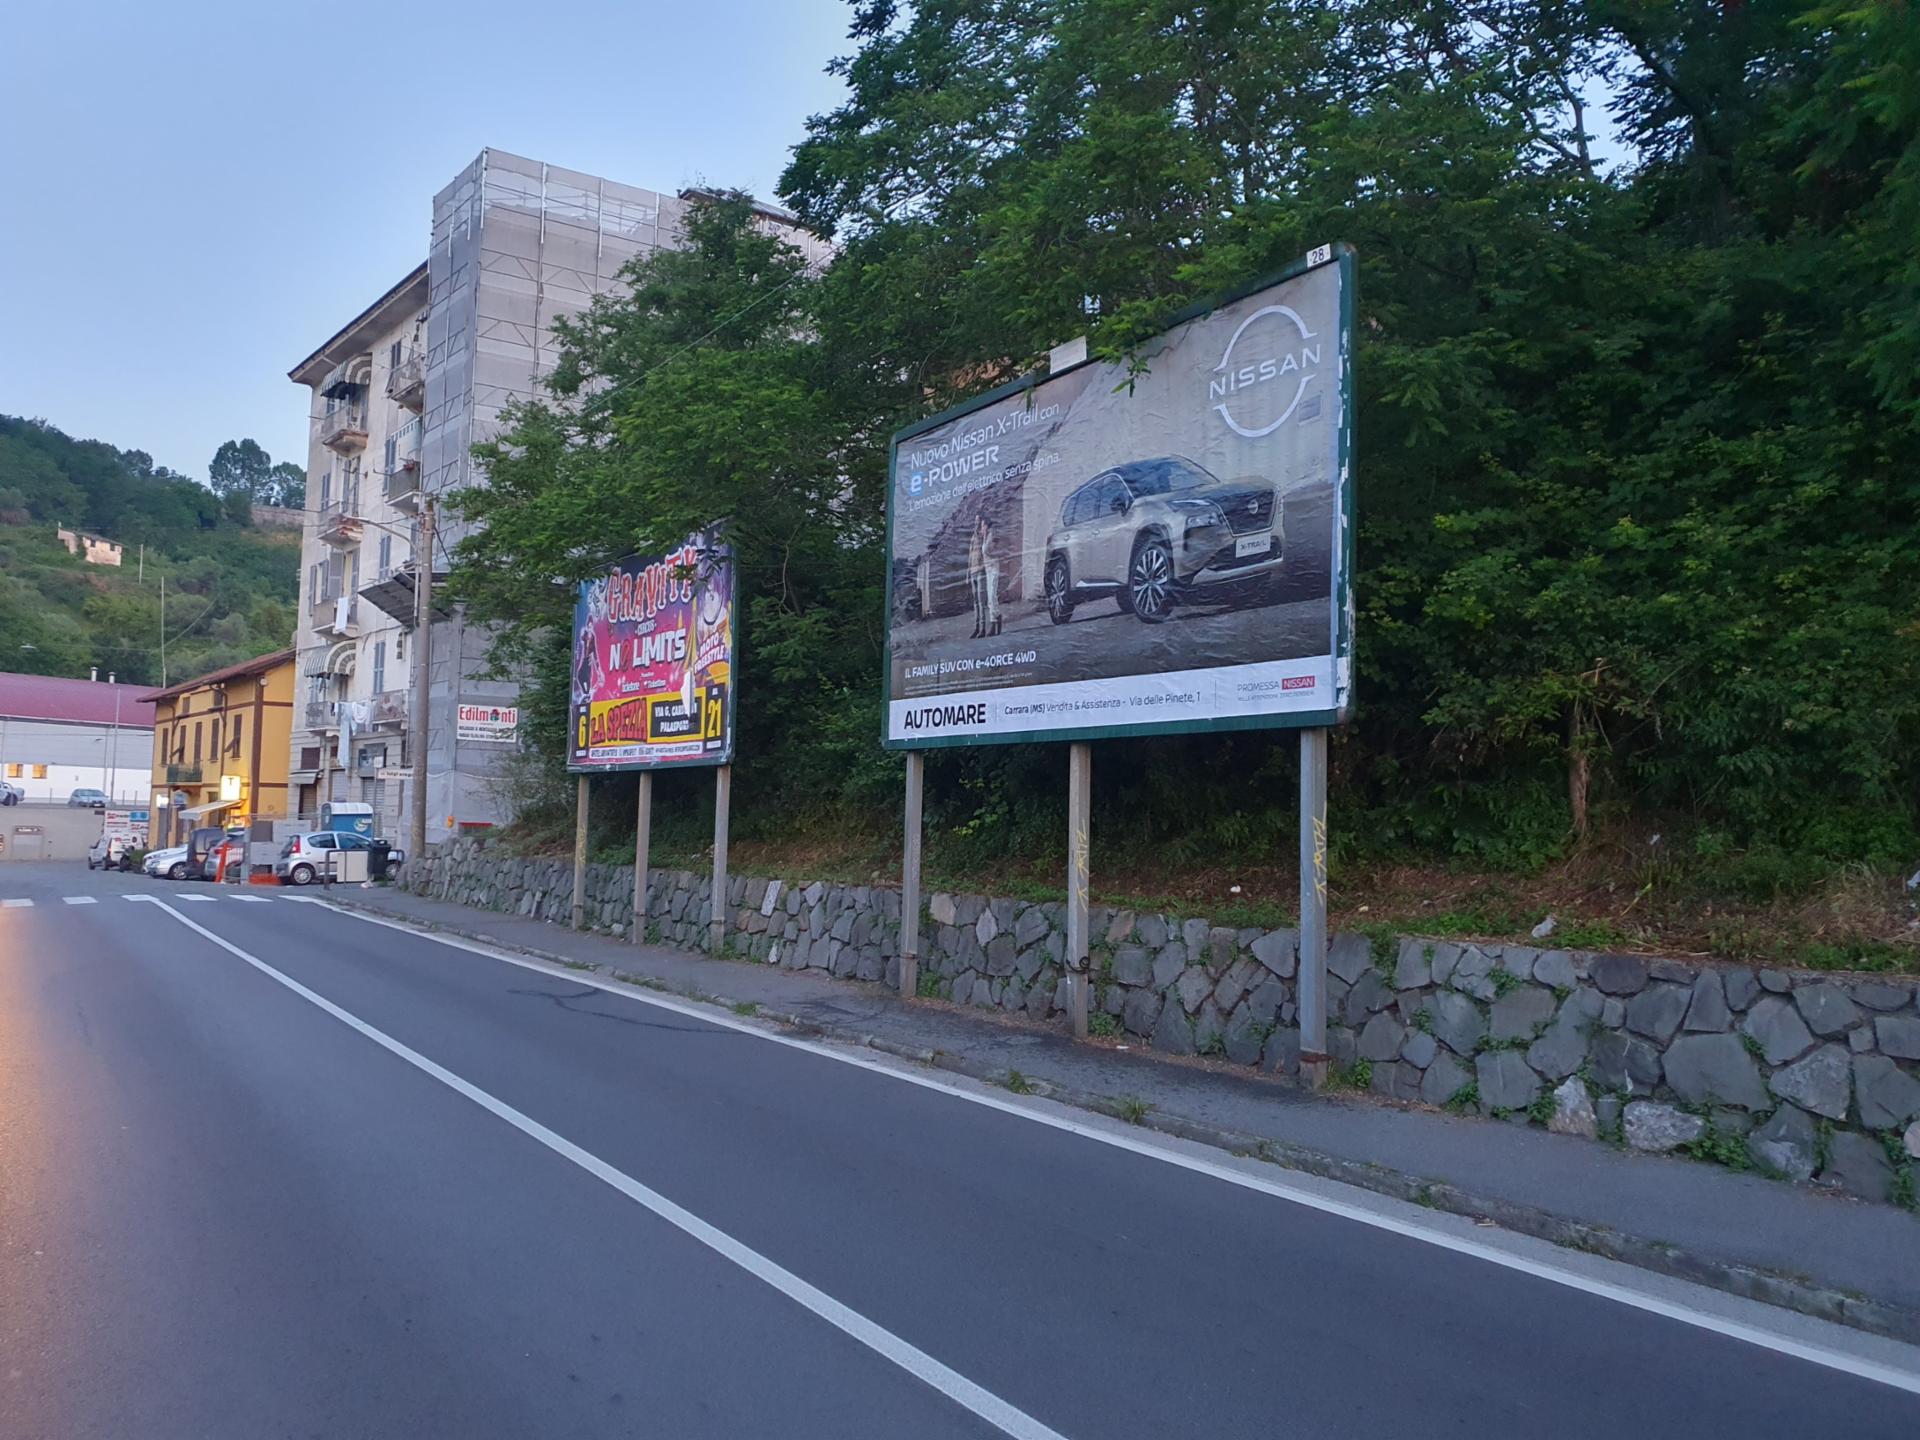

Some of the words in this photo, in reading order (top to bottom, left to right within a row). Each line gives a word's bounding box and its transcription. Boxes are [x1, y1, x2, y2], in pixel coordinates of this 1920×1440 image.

[1312, 248, 1325, 264] 28
[1209, 343, 1321, 400] NISSAN
[911, 443, 948, 469] Nuovo
[951, 424, 994, 450] Nissan
[996, 402, 1039, 437] X-Trail
[1040, 402, 1060, 420] con
[1004, 461, 1032, 481] senza
[607, 544, 698, 623] GRAVITY
[633, 628, 686, 668] LIMITS
[904, 667, 911, 679] IL
[912, 663, 938, 678] FAMILY
[939, 661, 956, 675] SUV
[956, 659, 974, 672] CON
[1015, 650, 1037, 664] 4WD
[1237, 681, 1280, 692] PROMESSA
[1283, 677, 1314, 689] NISSAN
[707, 699, 722, 738] 21
[904, 703, 987, 730] AUTOMARE
[1004, 705, 1029, 715] Carrara
[1030, 703, 1046, 715] (MS)
[1046, 700, 1073, 713] Vendita
[1074, 700, 1080, 710] &
[1081, 697, 1121, 710] Assistenza
[1130, 696, 1142, 707] Via
[1144, 693, 1164, 706] delle
[1165, 692, 1195, 705] Pinete,
[578, 715, 587, 748] 6
[590, 712, 606, 745] LA
[607, 698, 647, 742] SPEZIA
